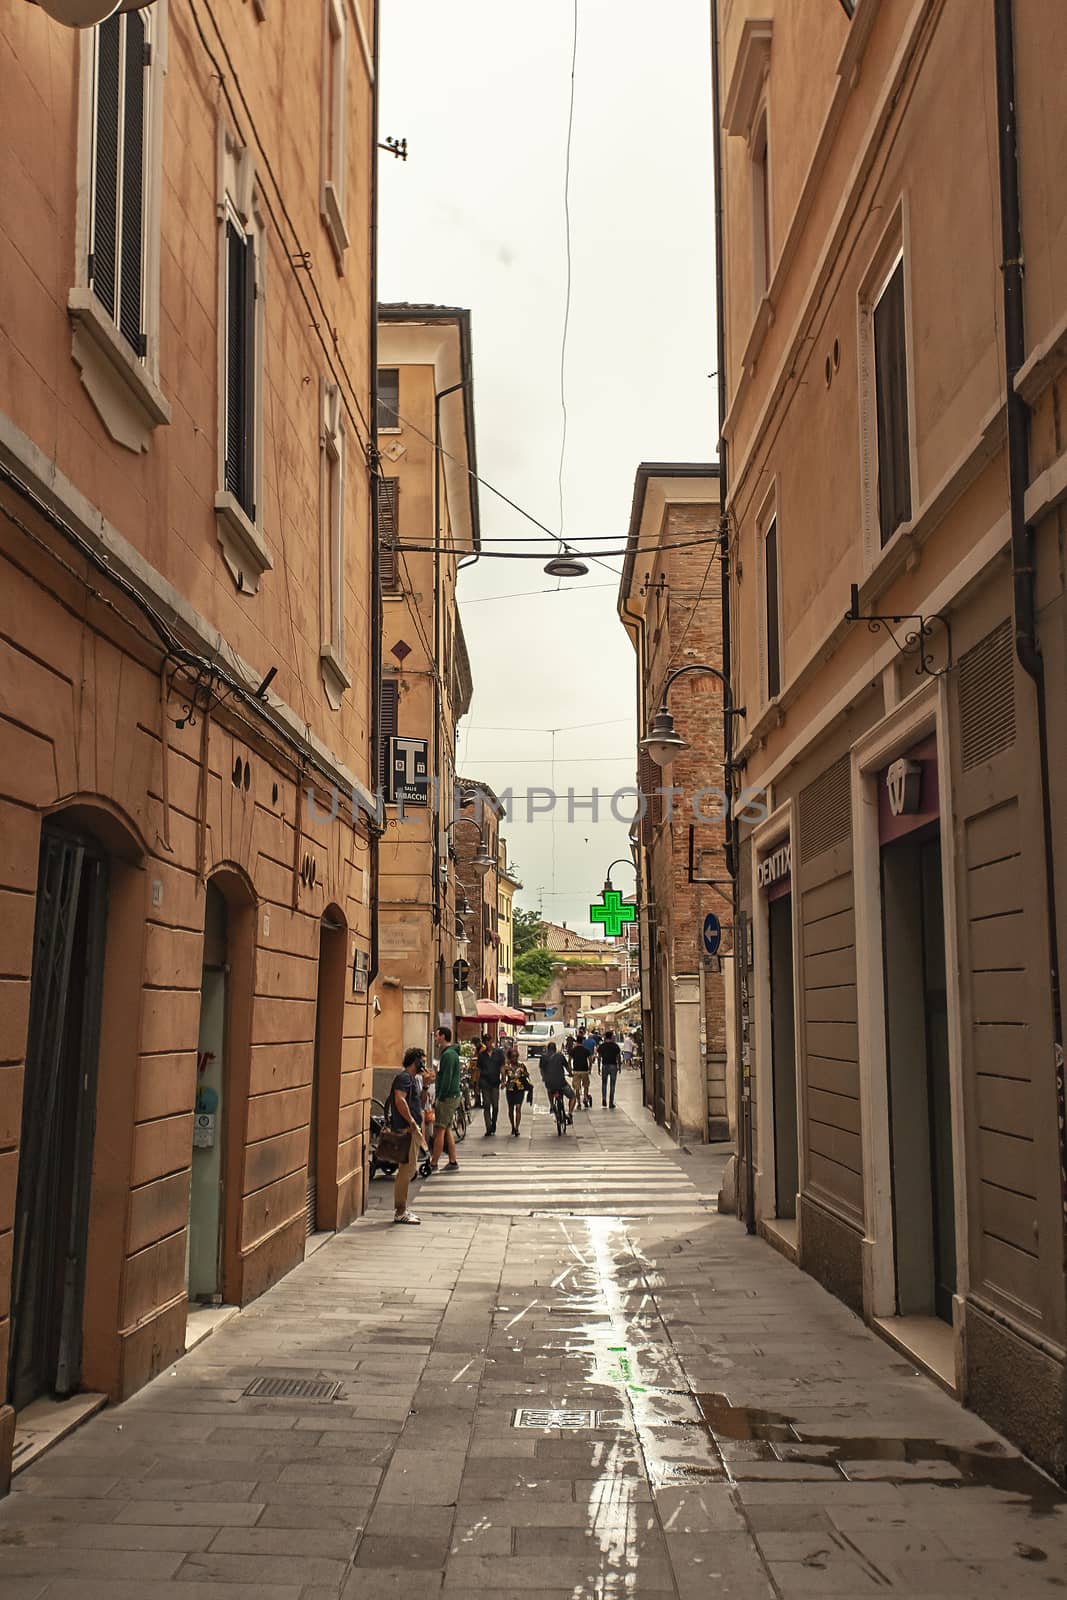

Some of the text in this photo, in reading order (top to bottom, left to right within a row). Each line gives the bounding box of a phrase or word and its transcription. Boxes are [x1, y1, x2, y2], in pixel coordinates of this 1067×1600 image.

[397, 741, 424, 784] T
[394, 791, 427, 801] TABACCHI
[757, 844, 791, 888] DENTIX
